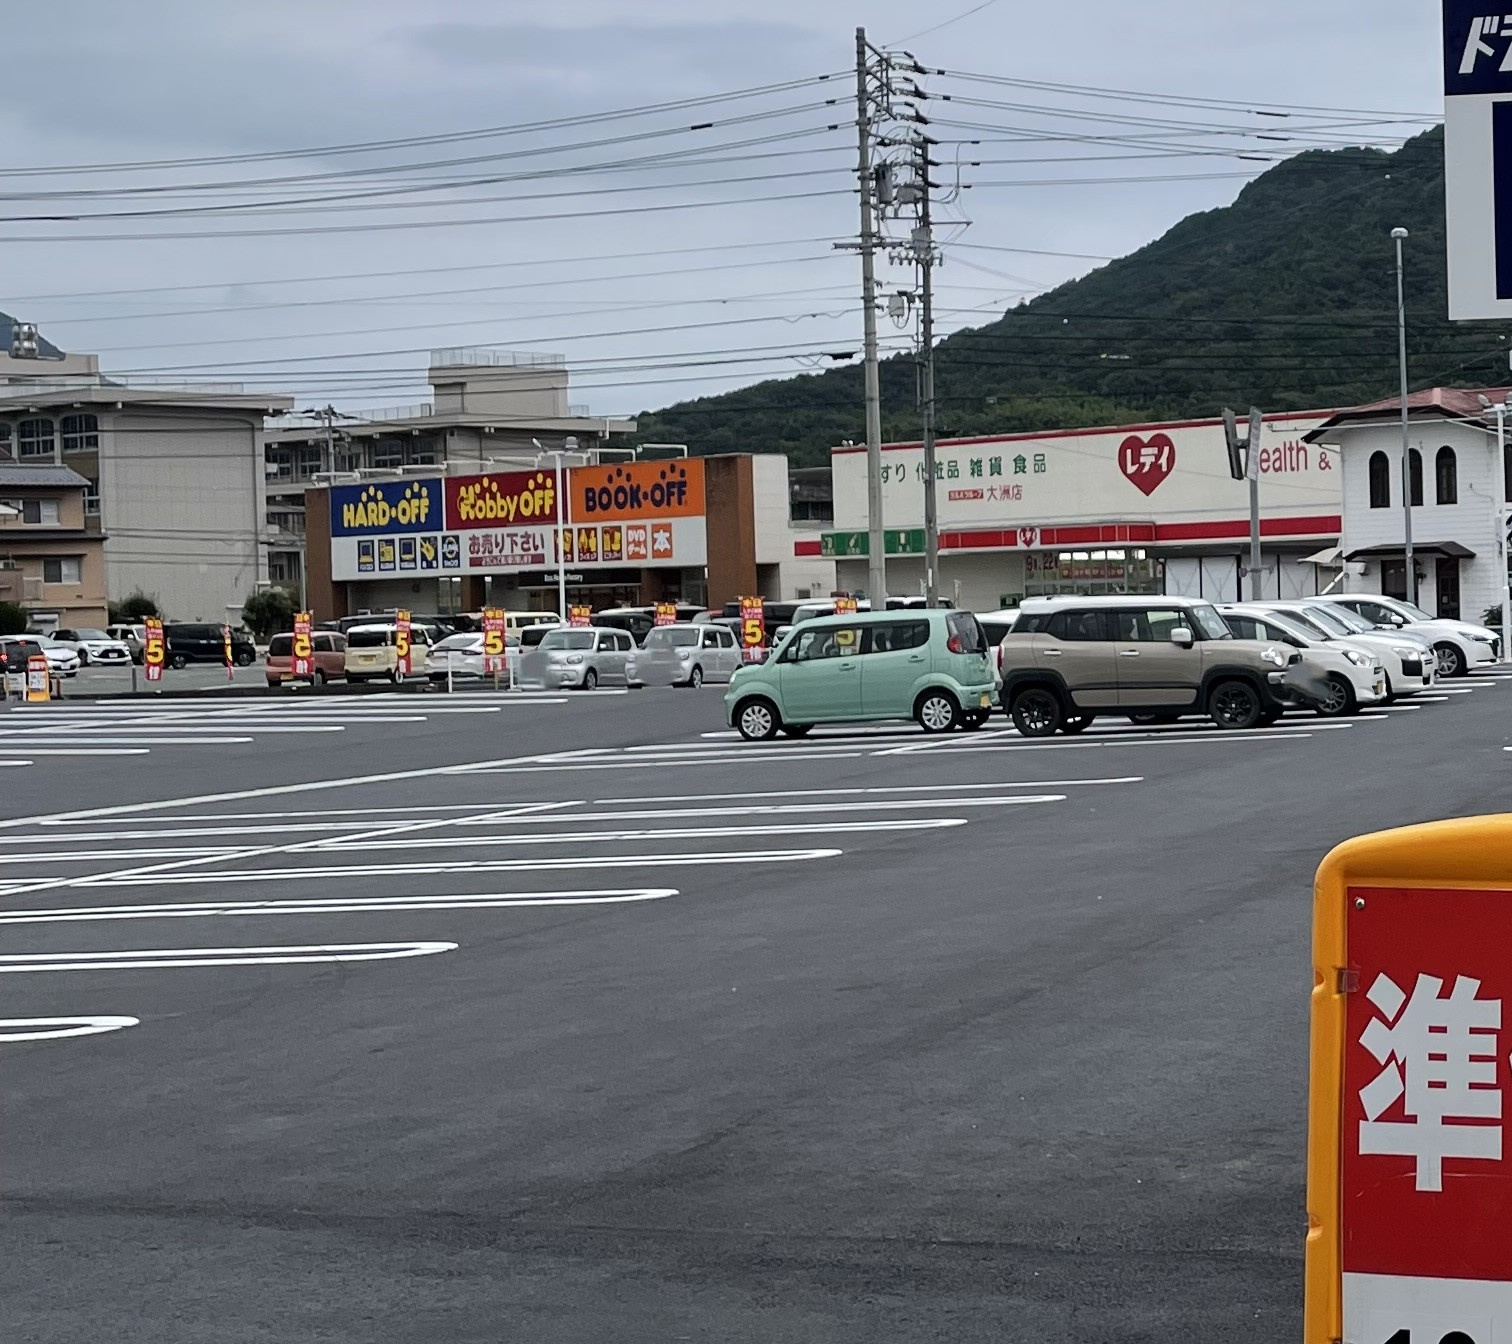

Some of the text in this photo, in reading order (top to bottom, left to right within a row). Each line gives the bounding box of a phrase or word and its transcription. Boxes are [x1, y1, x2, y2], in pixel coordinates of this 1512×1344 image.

[880, 463, 906, 484] すり
[970, 456, 1003, 479] 雑貨
[1012, 453, 1047, 475] 食品
[1126, 445, 1171, 475] レディ
[1259, 440, 1332, 474] ealth &
[469, 532, 545, 556] お売り下さい
[628, 529, 646, 543] DVD
[653, 528, 671, 553] 本
[485, 630, 503, 655] 5
[745, 619, 762, 644] 5
[146, 639, 164, 664] 5
[396, 632, 409, 657] 5
